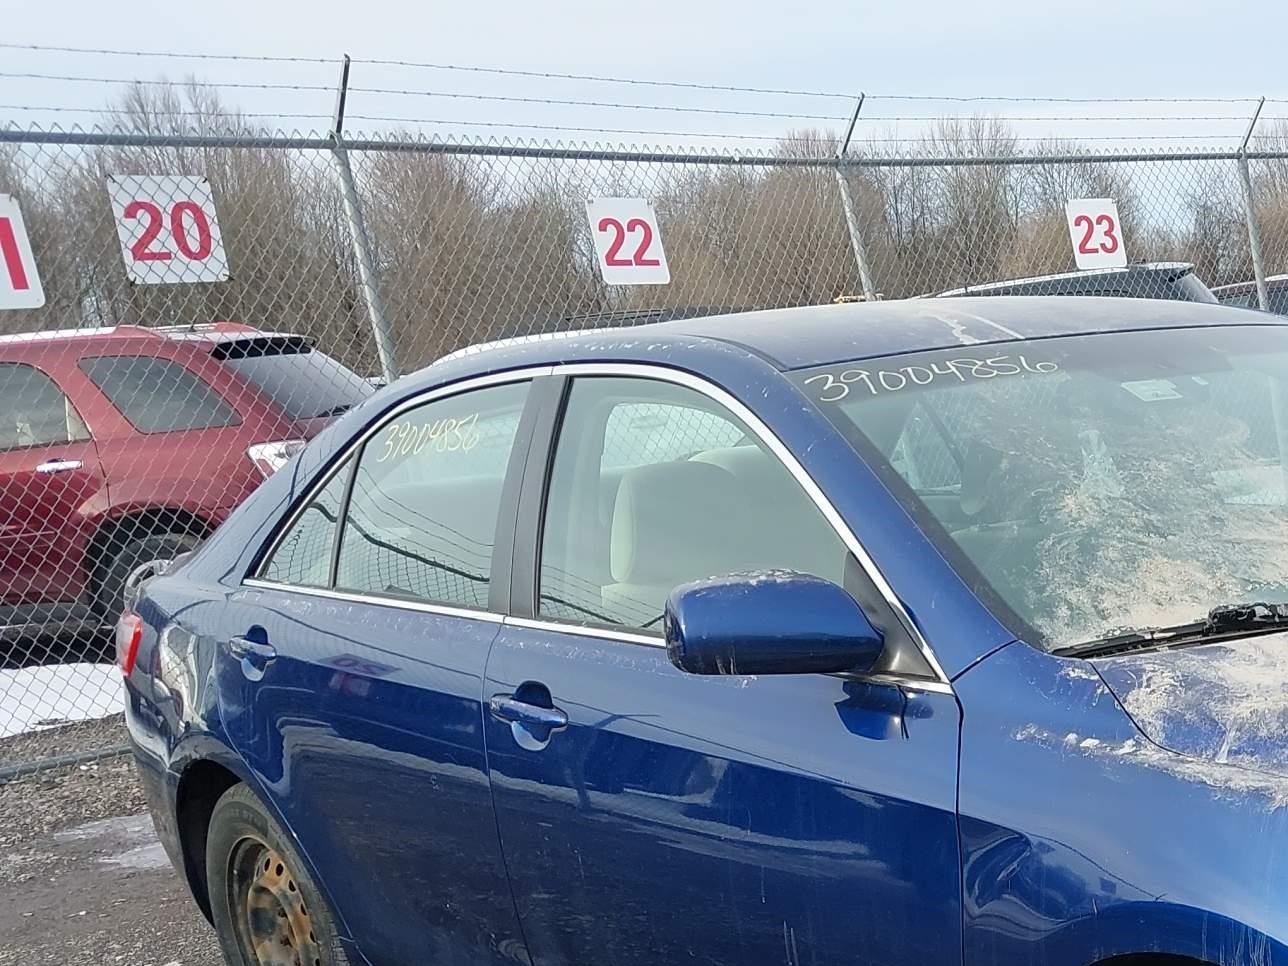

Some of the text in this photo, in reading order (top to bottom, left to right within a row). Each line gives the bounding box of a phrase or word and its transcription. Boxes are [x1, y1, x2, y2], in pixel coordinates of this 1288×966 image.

[124, 201, 212, 261] 20
[598, 218, 660, 266] 22
[1074, 214, 1118, 254] 23
[804, 355, 1058, 402] 39004856
[377, 412, 480, 463] 39004856
